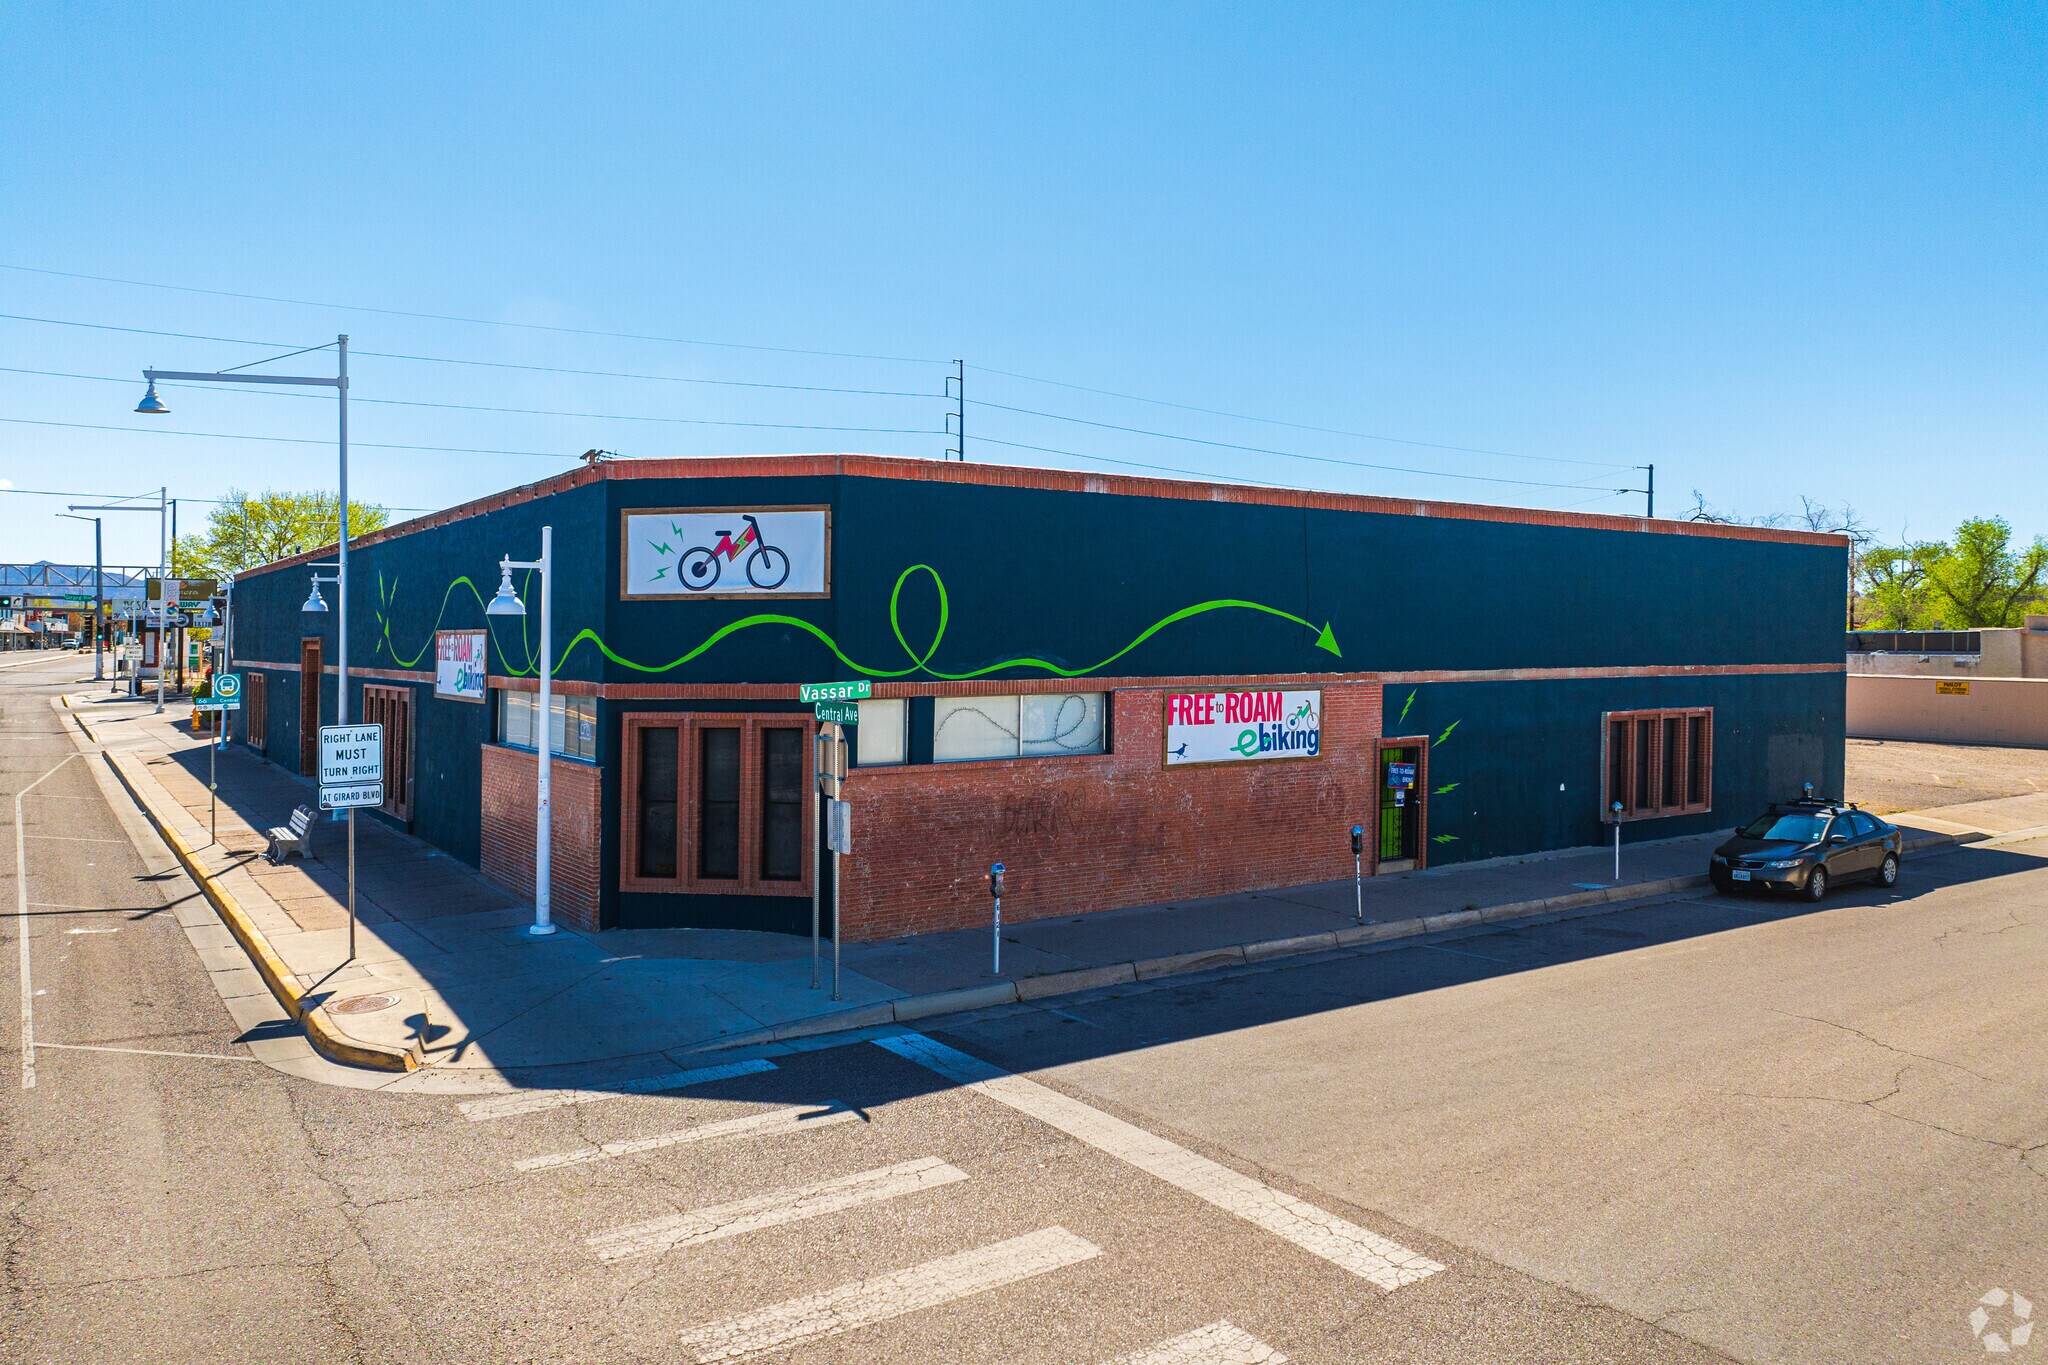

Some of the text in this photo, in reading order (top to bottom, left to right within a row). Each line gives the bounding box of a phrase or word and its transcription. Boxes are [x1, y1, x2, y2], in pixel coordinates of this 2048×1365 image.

[436, 634, 451, 661] FREE
[455, 634, 473, 662] ROAM
[801, 682, 870, 701] Vassar Dr
[815, 703, 858, 722] Central Ave
[1168, 692, 1283, 726] FREE to ROAM
[323, 732, 378, 744] RIGHT LANE
[1230, 723, 1319, 756] ebiking
[336, 749, 367, 760] MUST
[323, 765, 379, 777] TURN RIGHT
[323, 790, 380, 802] AT GIRARD BLVD
